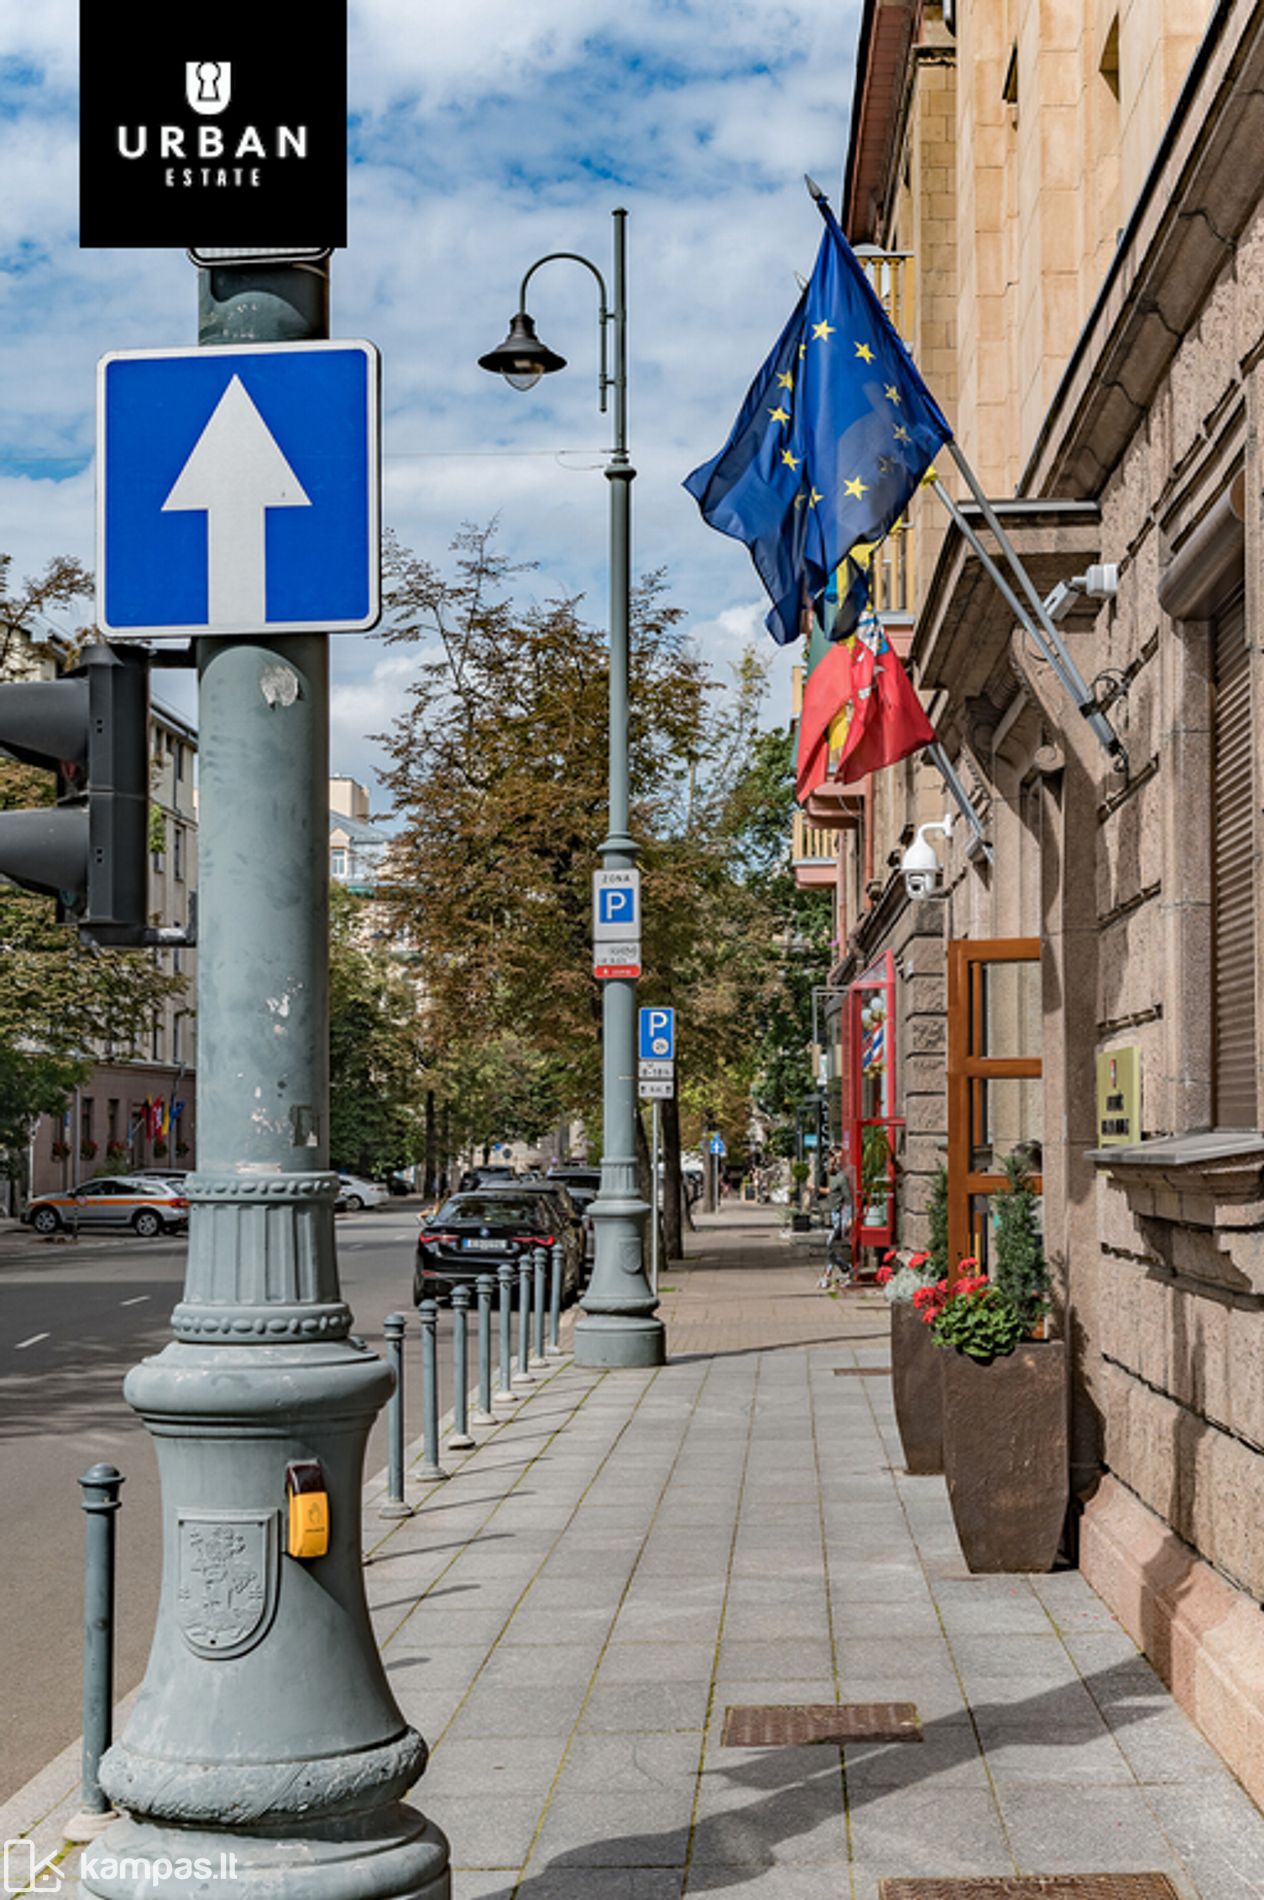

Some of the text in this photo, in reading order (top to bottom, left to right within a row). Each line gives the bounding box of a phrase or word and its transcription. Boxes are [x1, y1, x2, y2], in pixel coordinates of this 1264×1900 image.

[602, 873, 631, 884] ZONA
[606, 891, 627, 920] P
[649, 1011, 669, 1038] P
